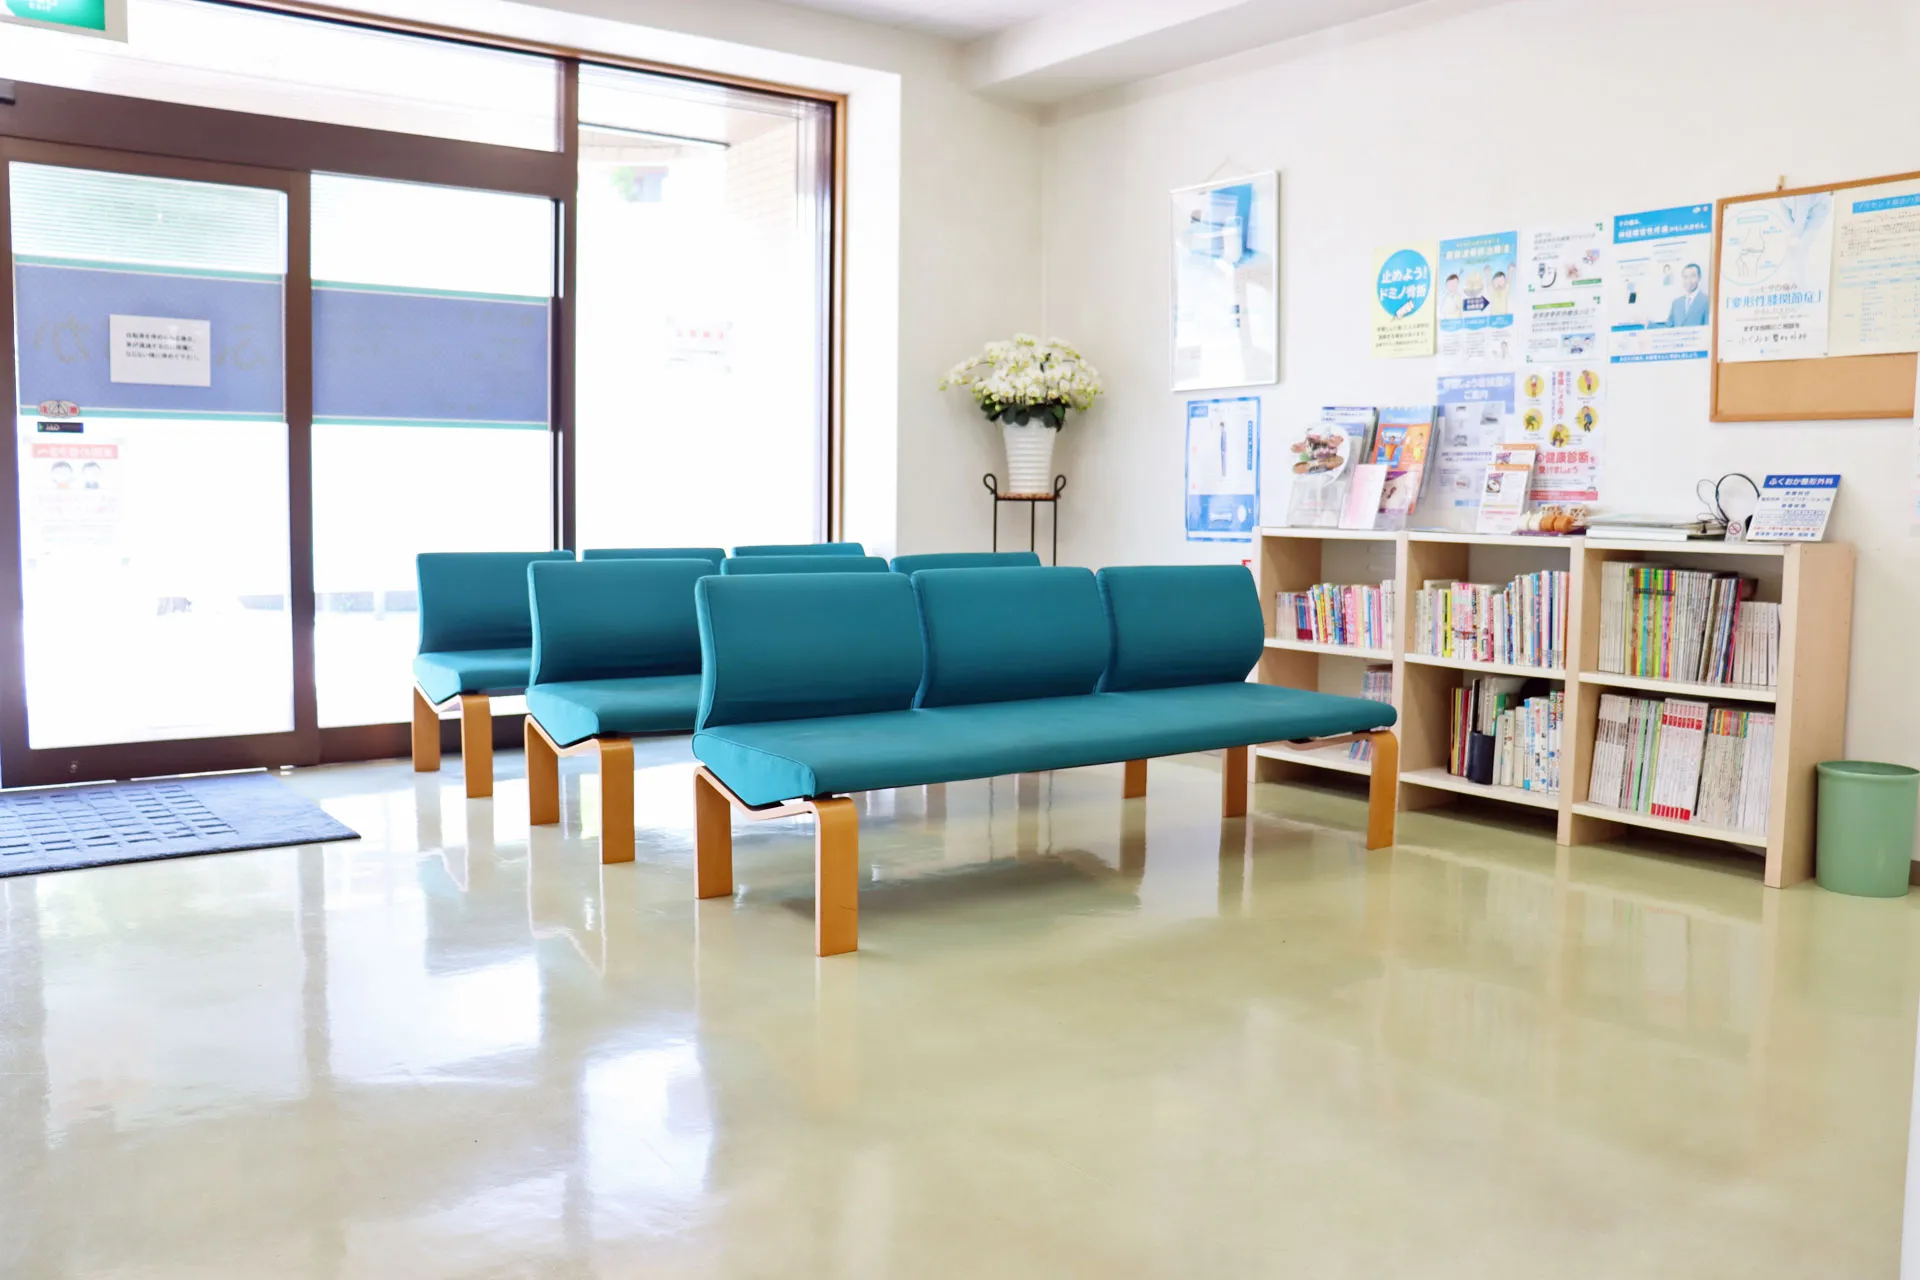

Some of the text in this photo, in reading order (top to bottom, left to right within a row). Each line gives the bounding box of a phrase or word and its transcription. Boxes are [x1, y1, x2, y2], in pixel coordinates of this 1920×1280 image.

[1768, 477, 1834, 486] ふくおか整形外科
